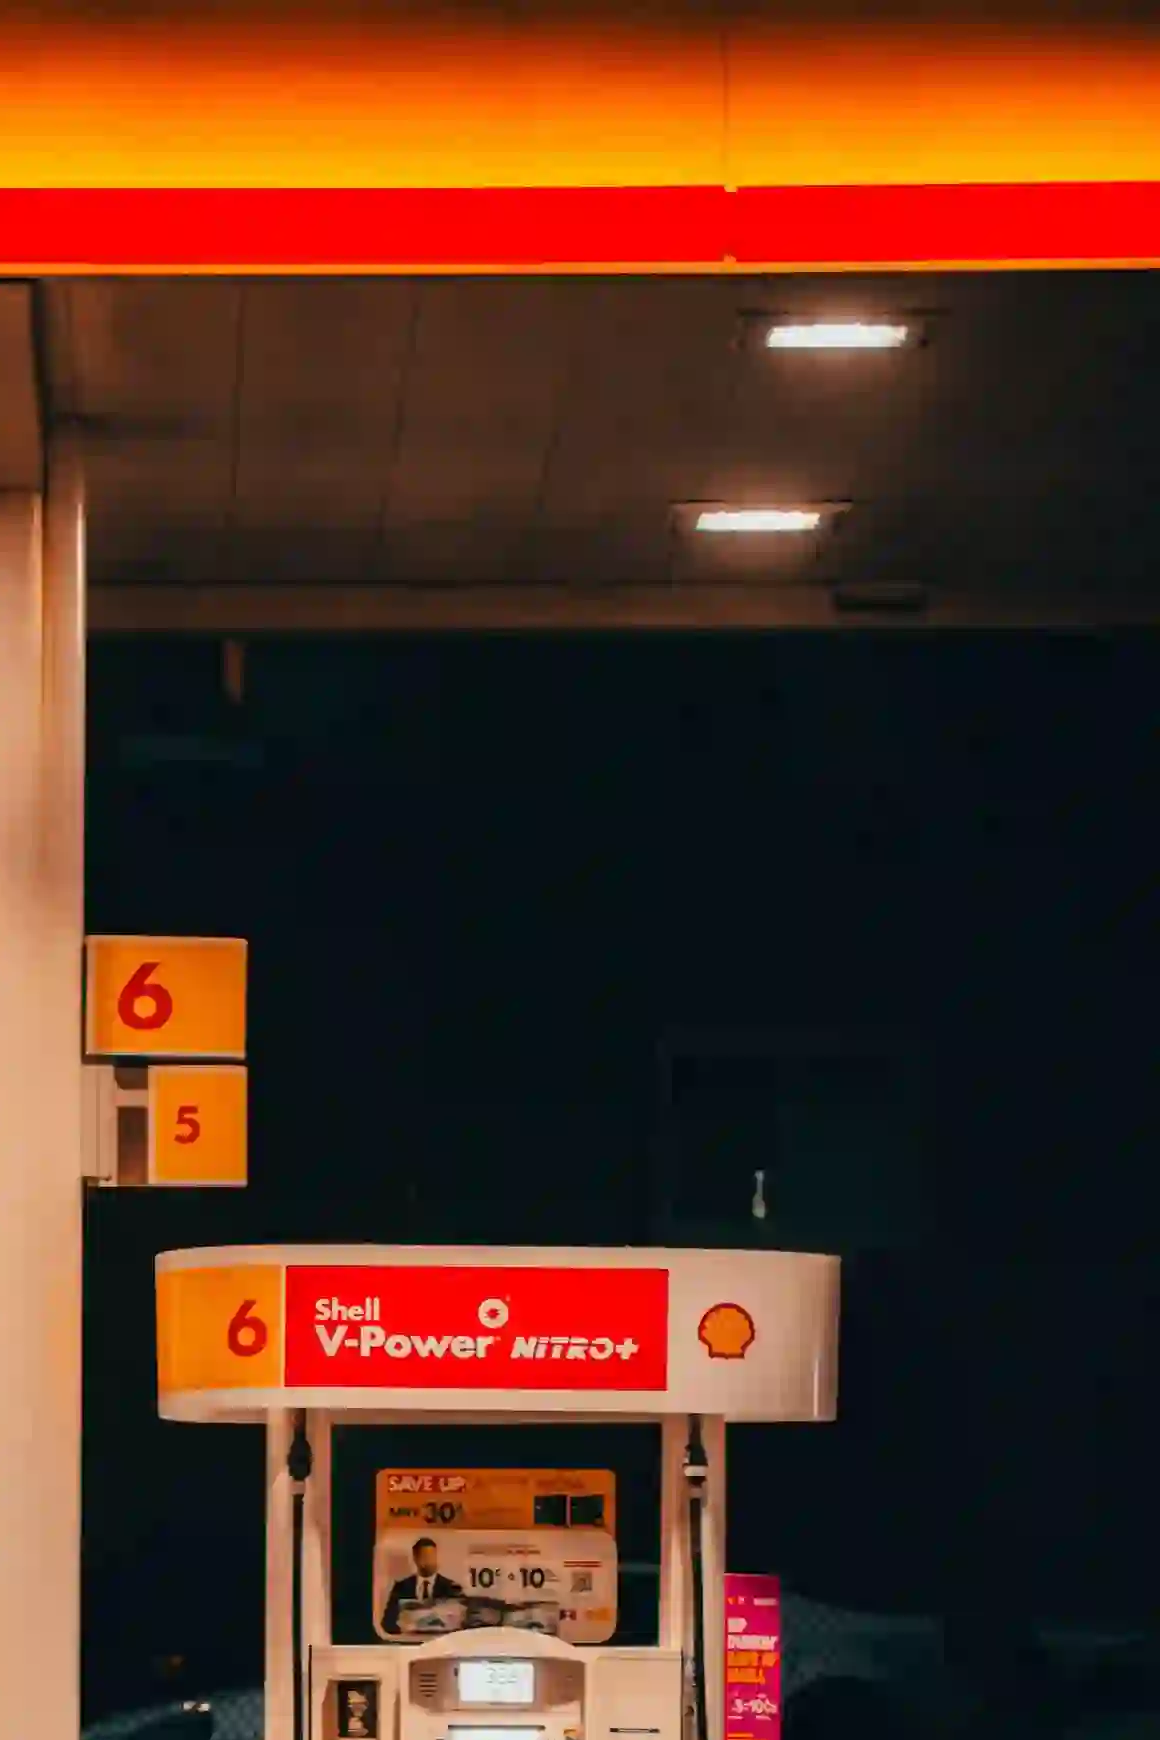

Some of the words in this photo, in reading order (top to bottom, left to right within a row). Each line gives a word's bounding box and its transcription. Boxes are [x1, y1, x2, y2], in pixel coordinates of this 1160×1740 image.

[118, 961, 173, 1030] 6
[173, 1105, 201, 1144] 5
[315, 1296, 381, 1321] Shell
[227, 1299, 268, 1357] 6
[315, 1324, 495, 1358] V-Power
[388, 1475, 433, 1493] SAVE
